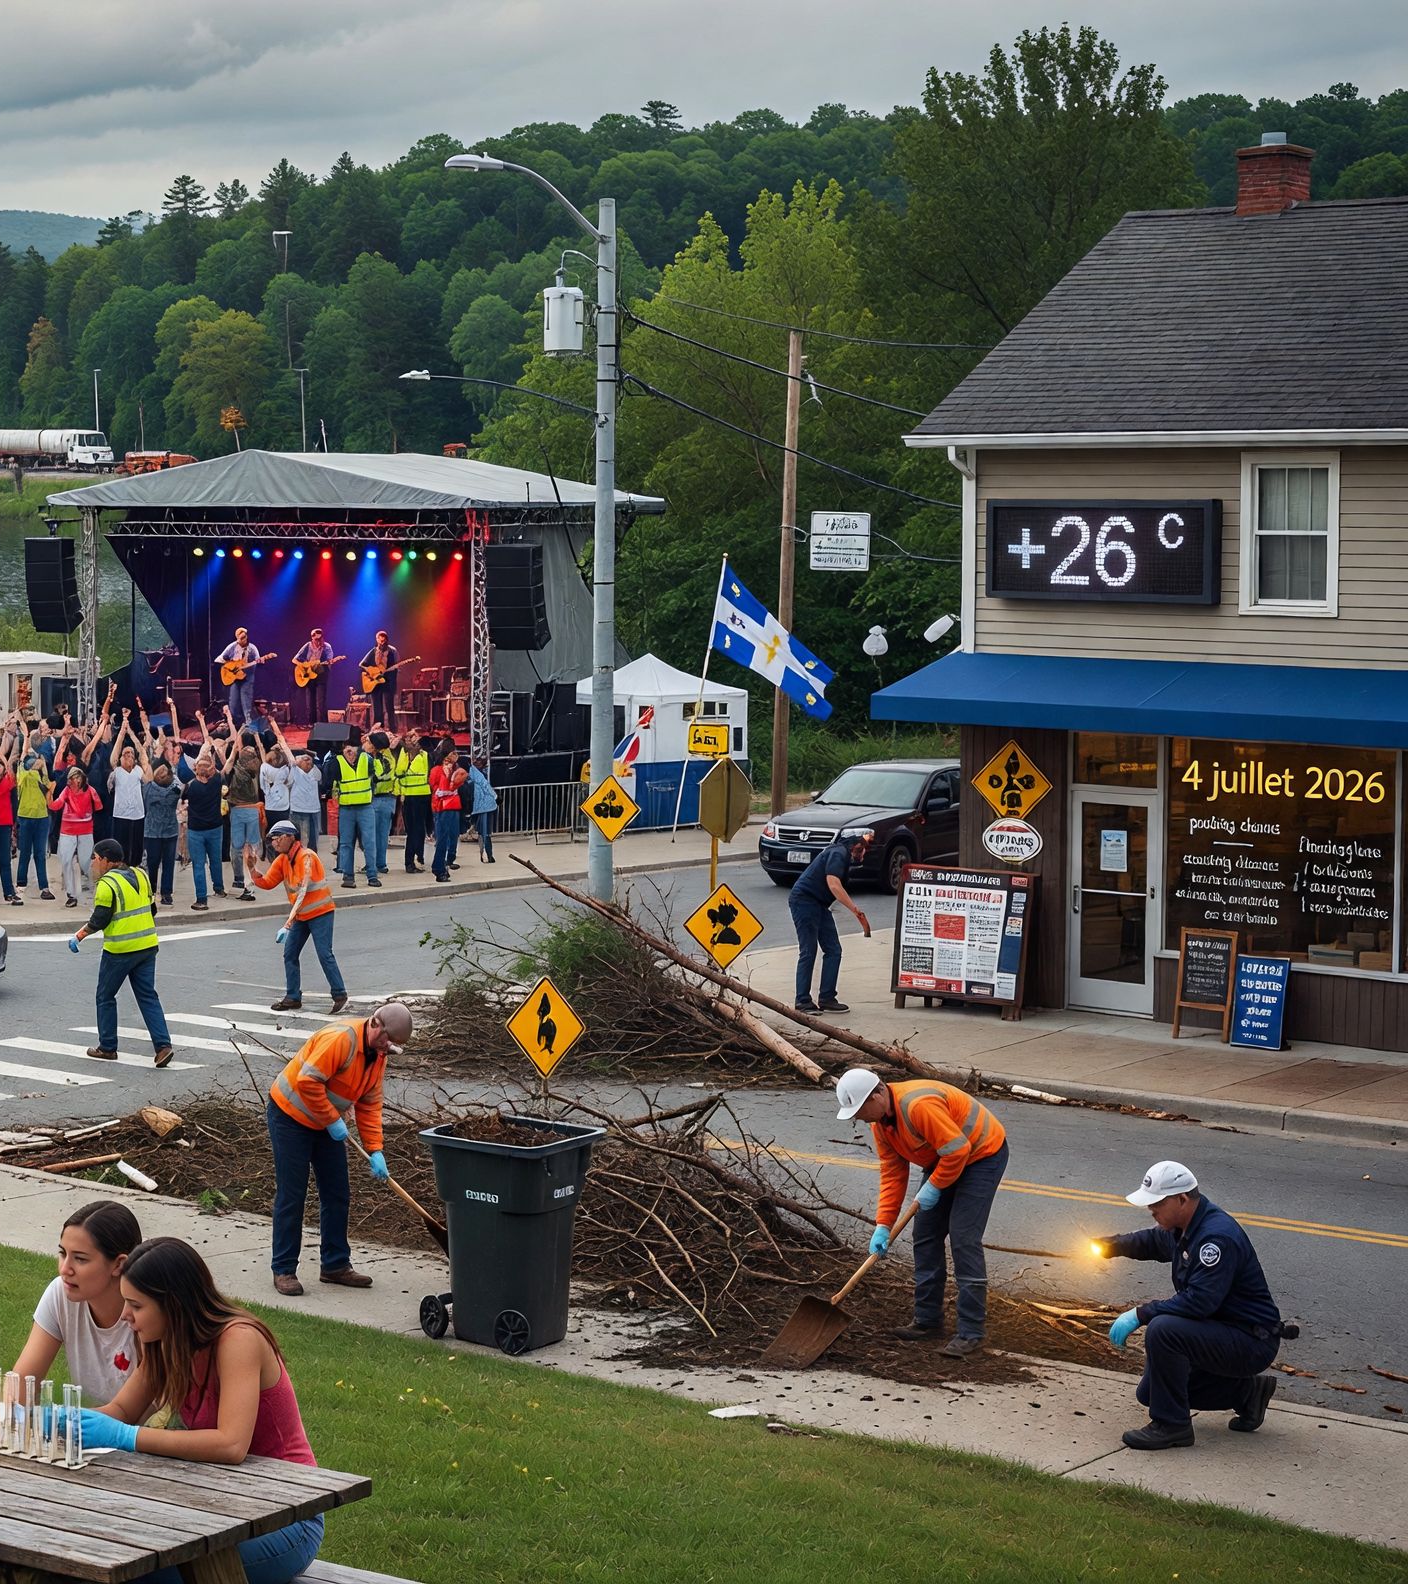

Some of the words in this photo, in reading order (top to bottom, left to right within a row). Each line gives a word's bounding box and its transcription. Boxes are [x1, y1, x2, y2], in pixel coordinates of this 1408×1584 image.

[1008, 515, 1137, 587] +26
[1157, 512, 1185, 549] C
[1181, 760, 1203, 791] 4
[1206, 760, 1295, 802] juillet
[1304, 766, 1386, 804] 2026
